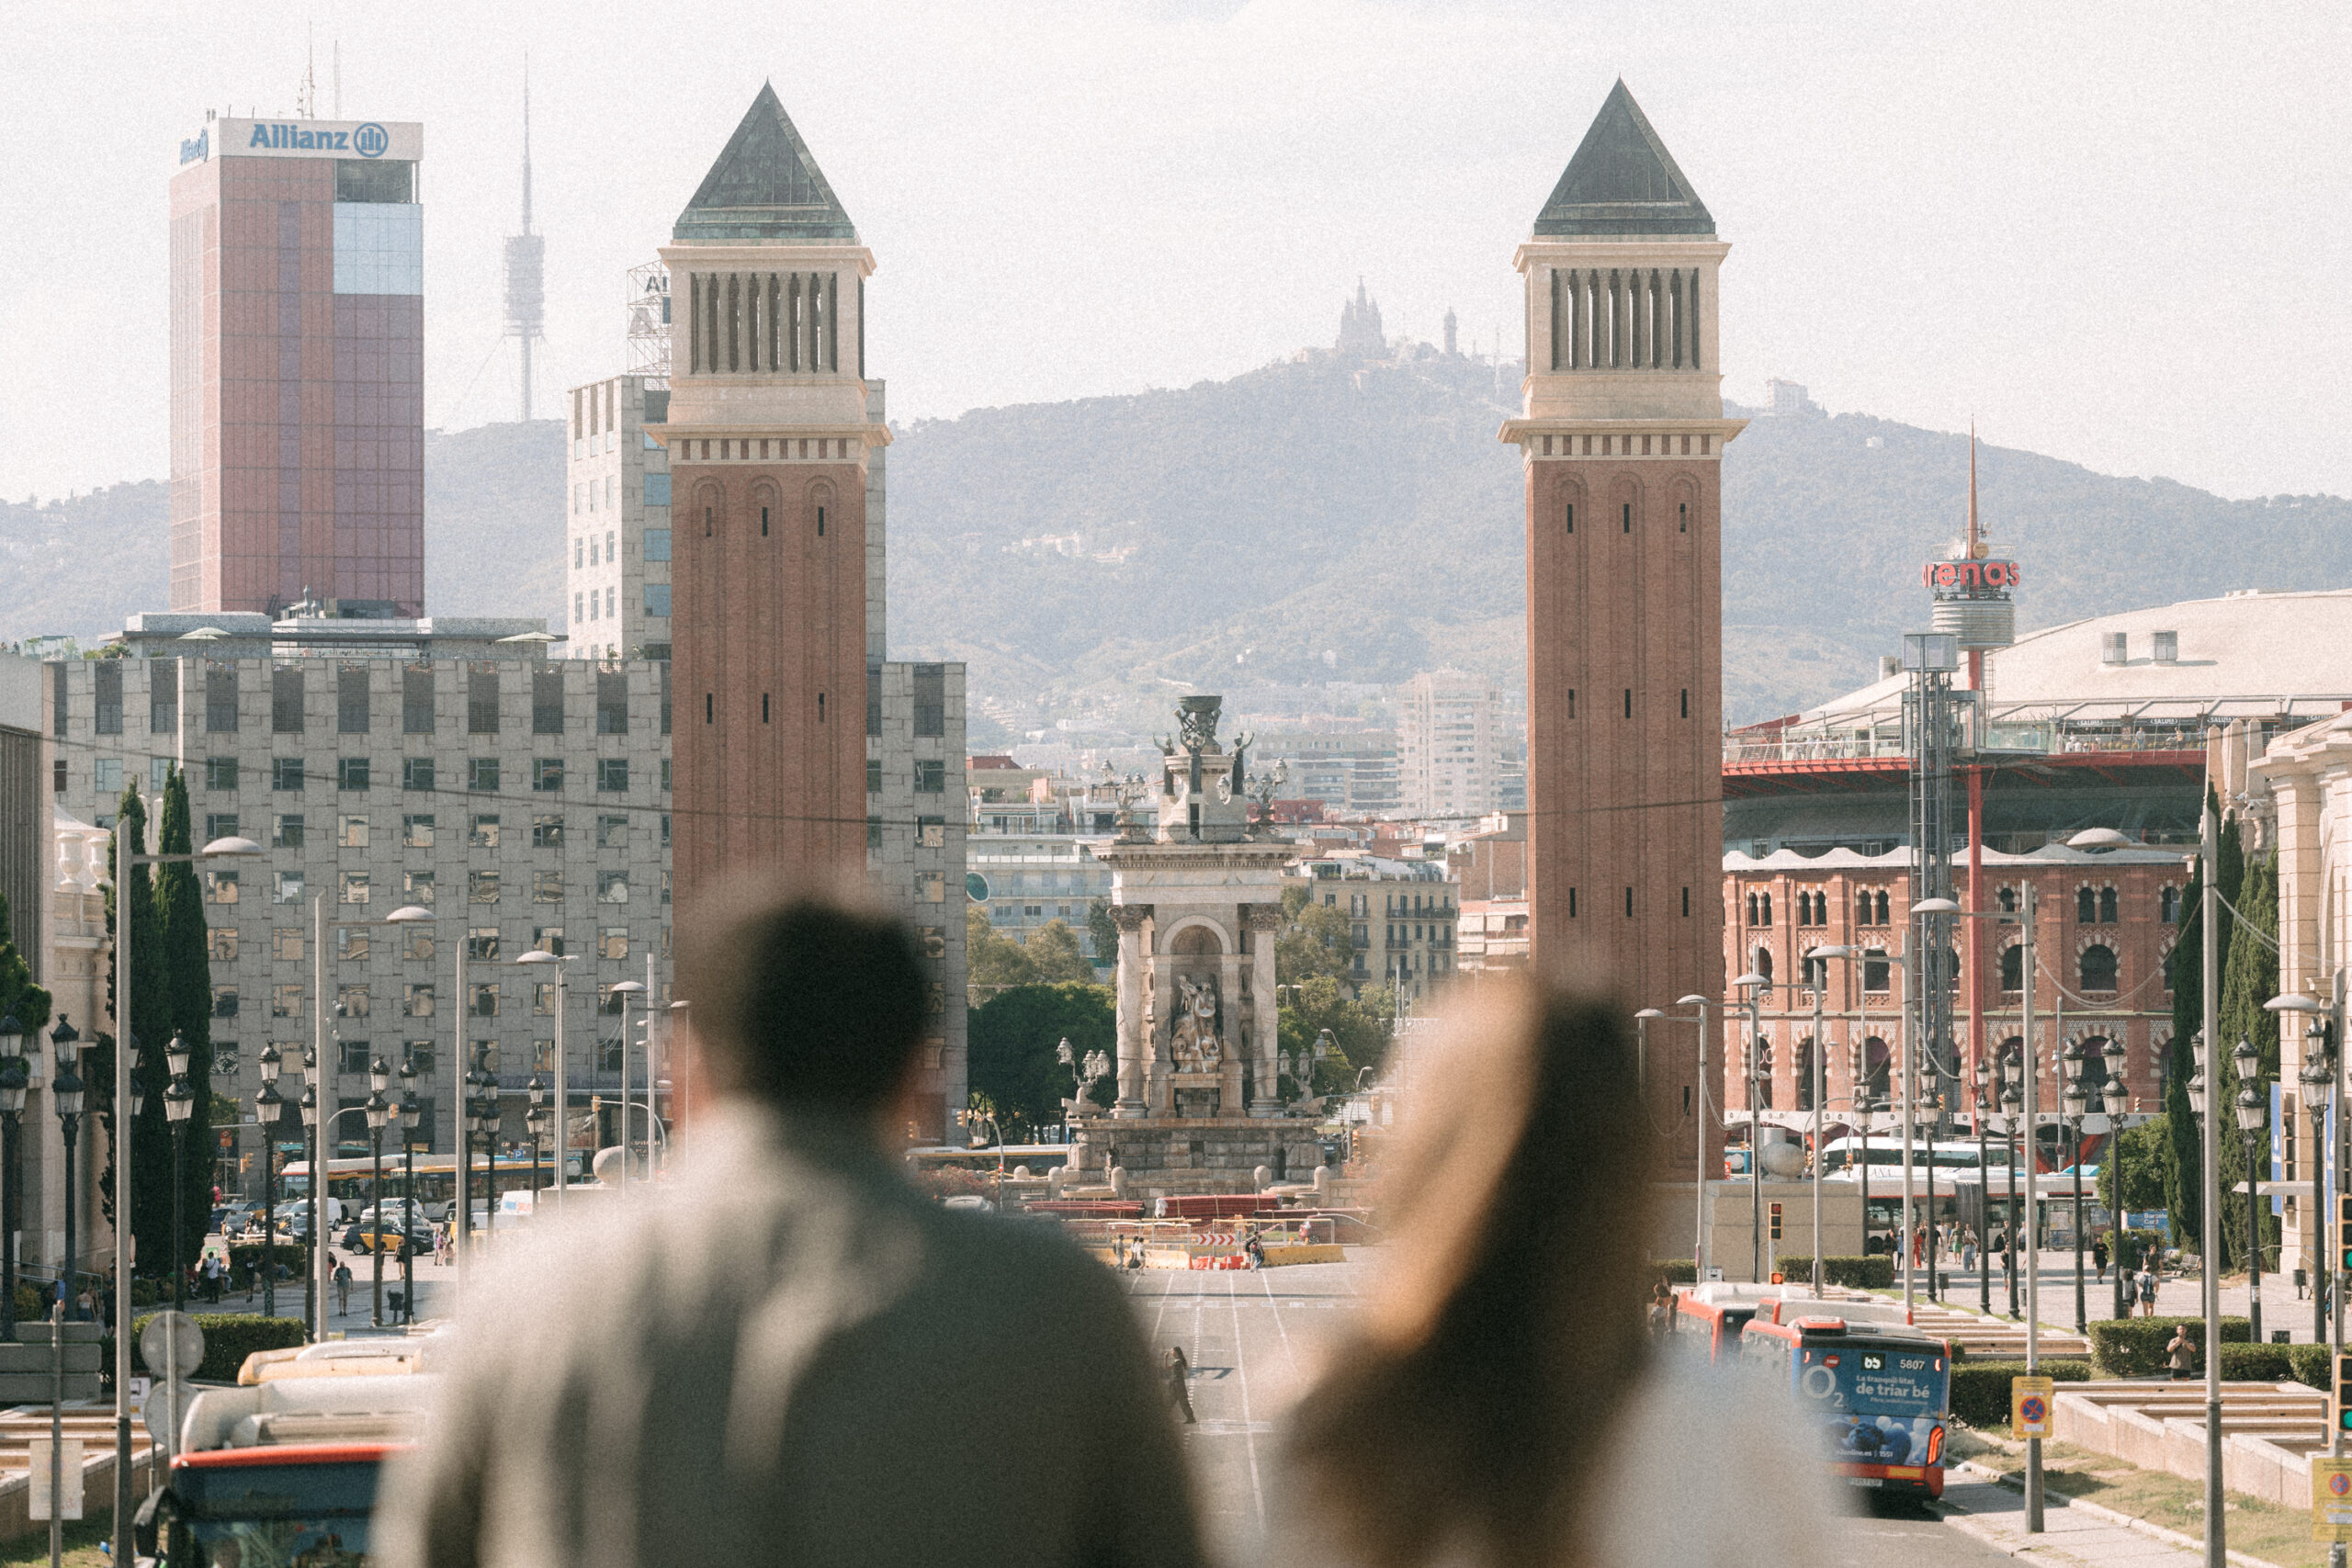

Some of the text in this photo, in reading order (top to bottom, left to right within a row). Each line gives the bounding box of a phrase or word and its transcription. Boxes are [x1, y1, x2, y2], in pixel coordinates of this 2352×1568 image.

[250, 123, 349, 150] Allianz
[1922, 561, 2020, 588] arenas
[1899, 1359, 1926, 1371] 5807
[1856, 1382, 1930, 1398] de triar bé
